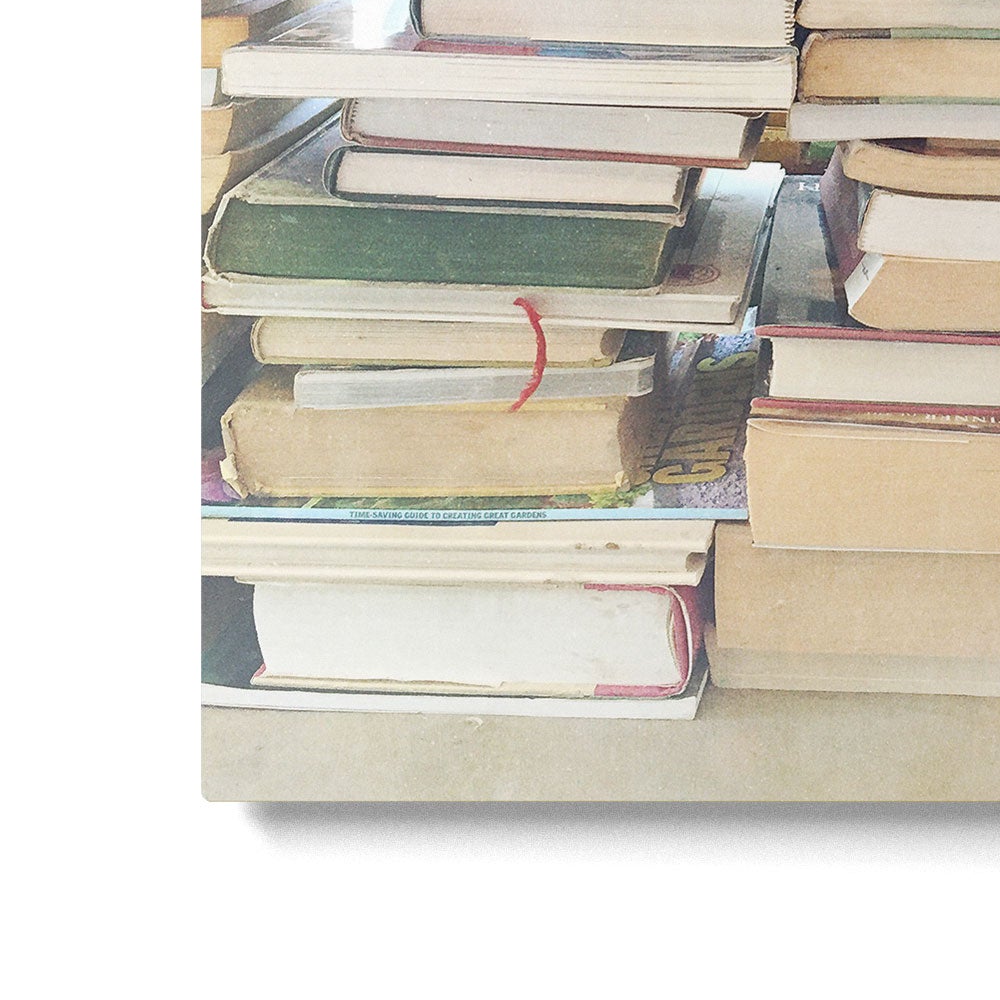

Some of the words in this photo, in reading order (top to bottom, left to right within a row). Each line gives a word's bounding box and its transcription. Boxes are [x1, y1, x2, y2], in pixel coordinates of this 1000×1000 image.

[349, 511, 403, 519] TIME-SAVING
[404, 511, 429, 519] GUIDE
[431, 511, 442, 519] TO
[443, 511, 482, 519] CREATING
[484, 511, 509, 519] GREAT
[510, 511, 548, 519] GARDENS
